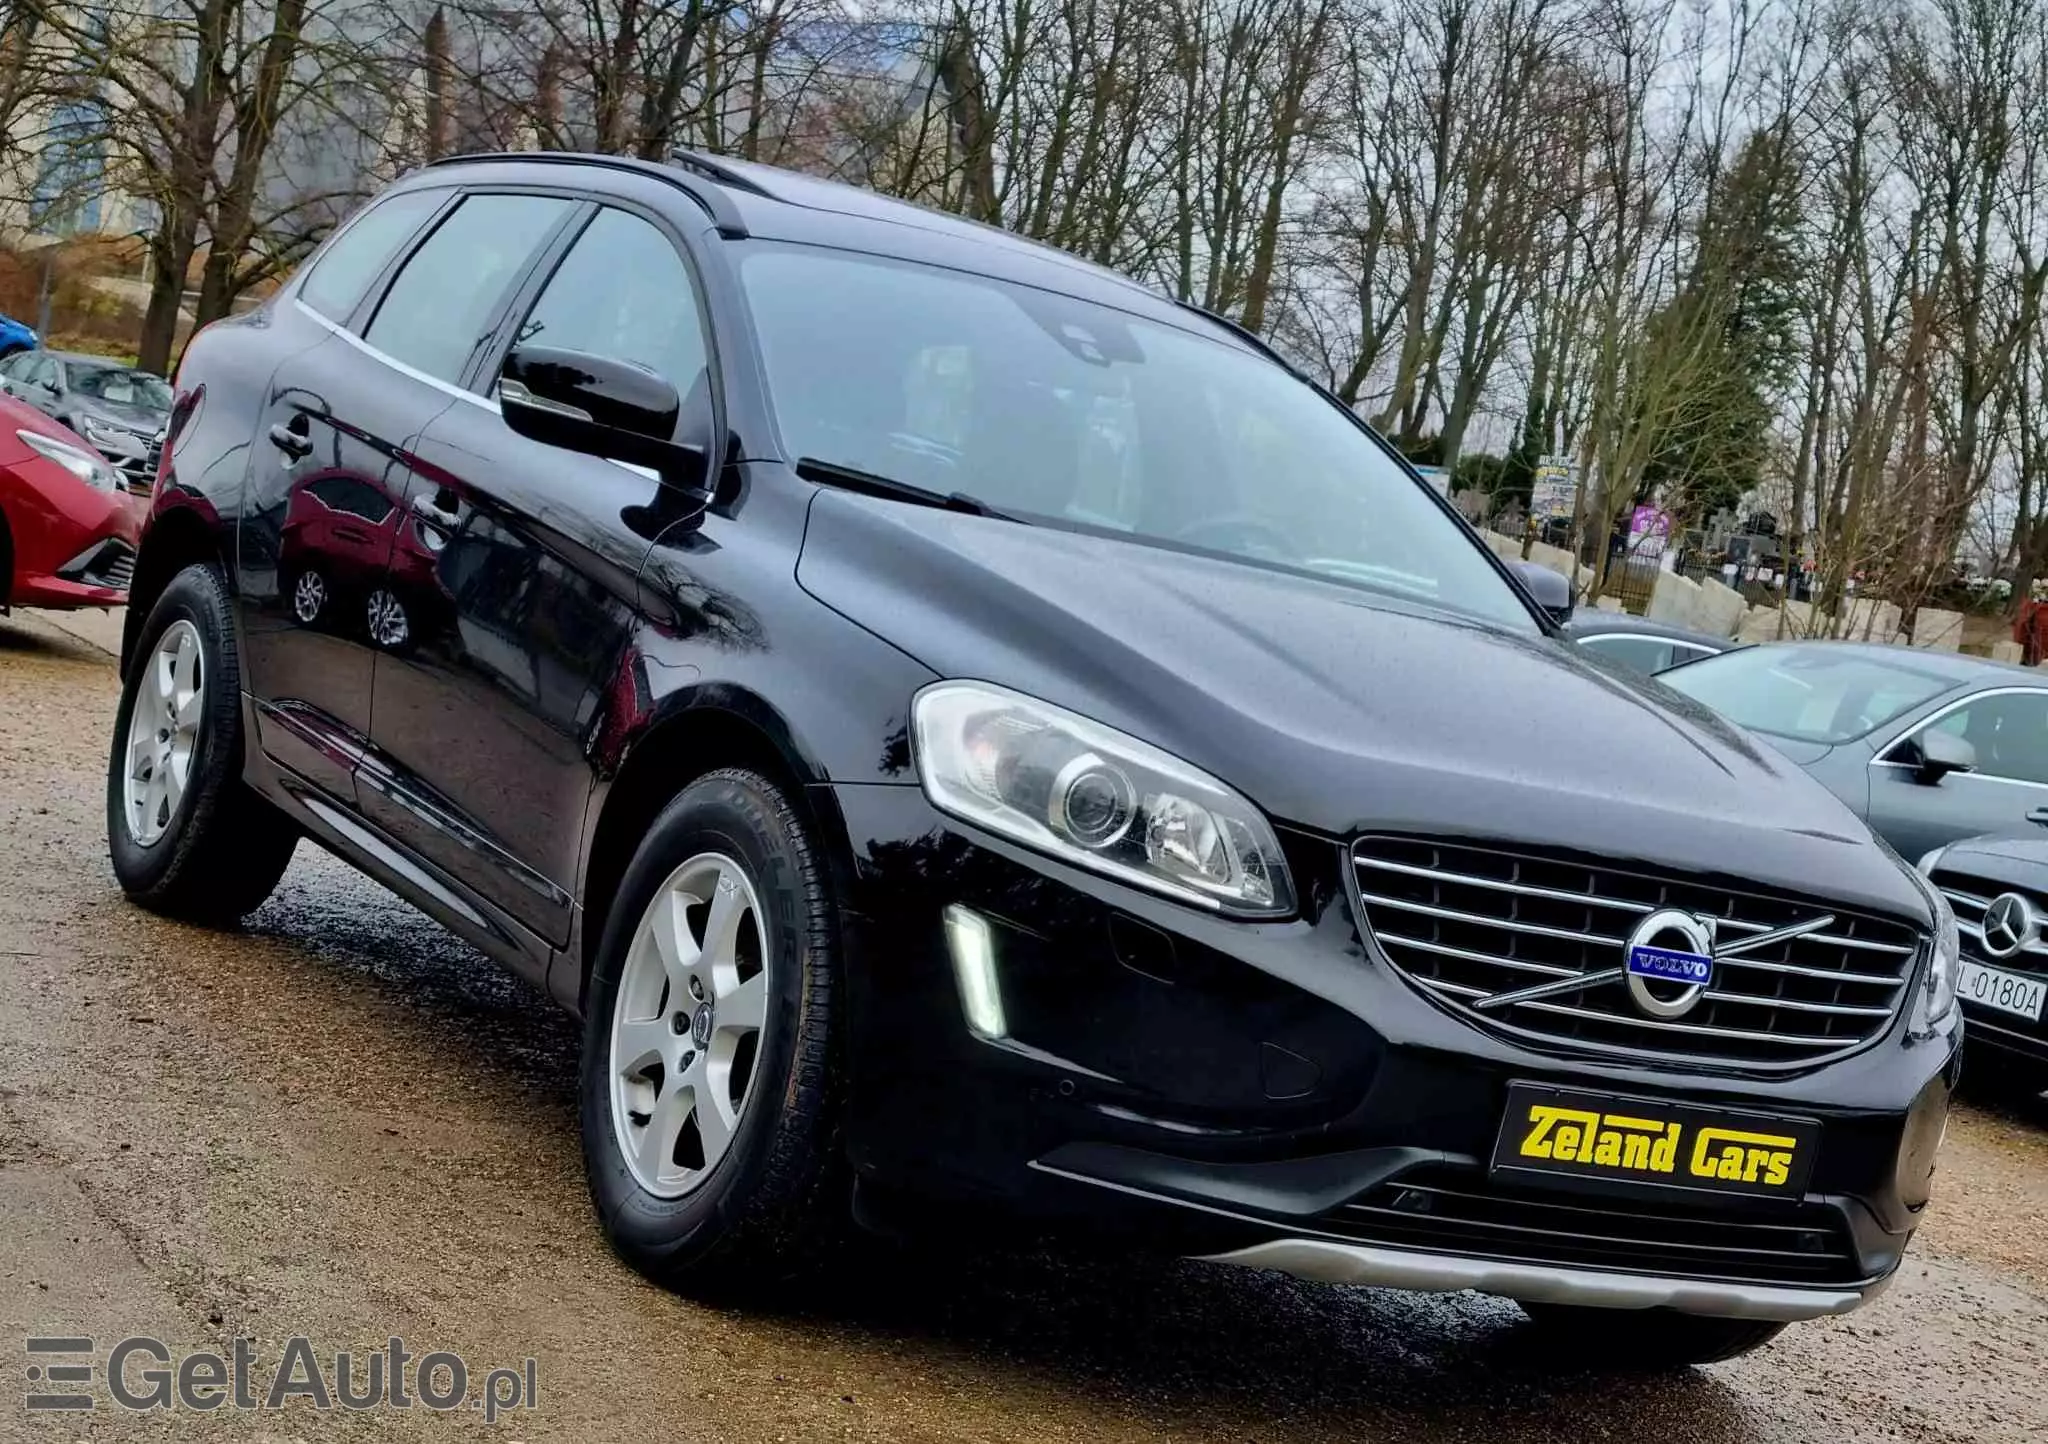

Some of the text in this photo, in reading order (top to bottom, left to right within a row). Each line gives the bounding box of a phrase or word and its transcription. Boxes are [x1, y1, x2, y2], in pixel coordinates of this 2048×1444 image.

[1636, 952, 1708, 977] VOLVO
[1975, 972, 2039, 1017] 0180A
[1520, 1106, 1797, 1185] Zeland Cars
